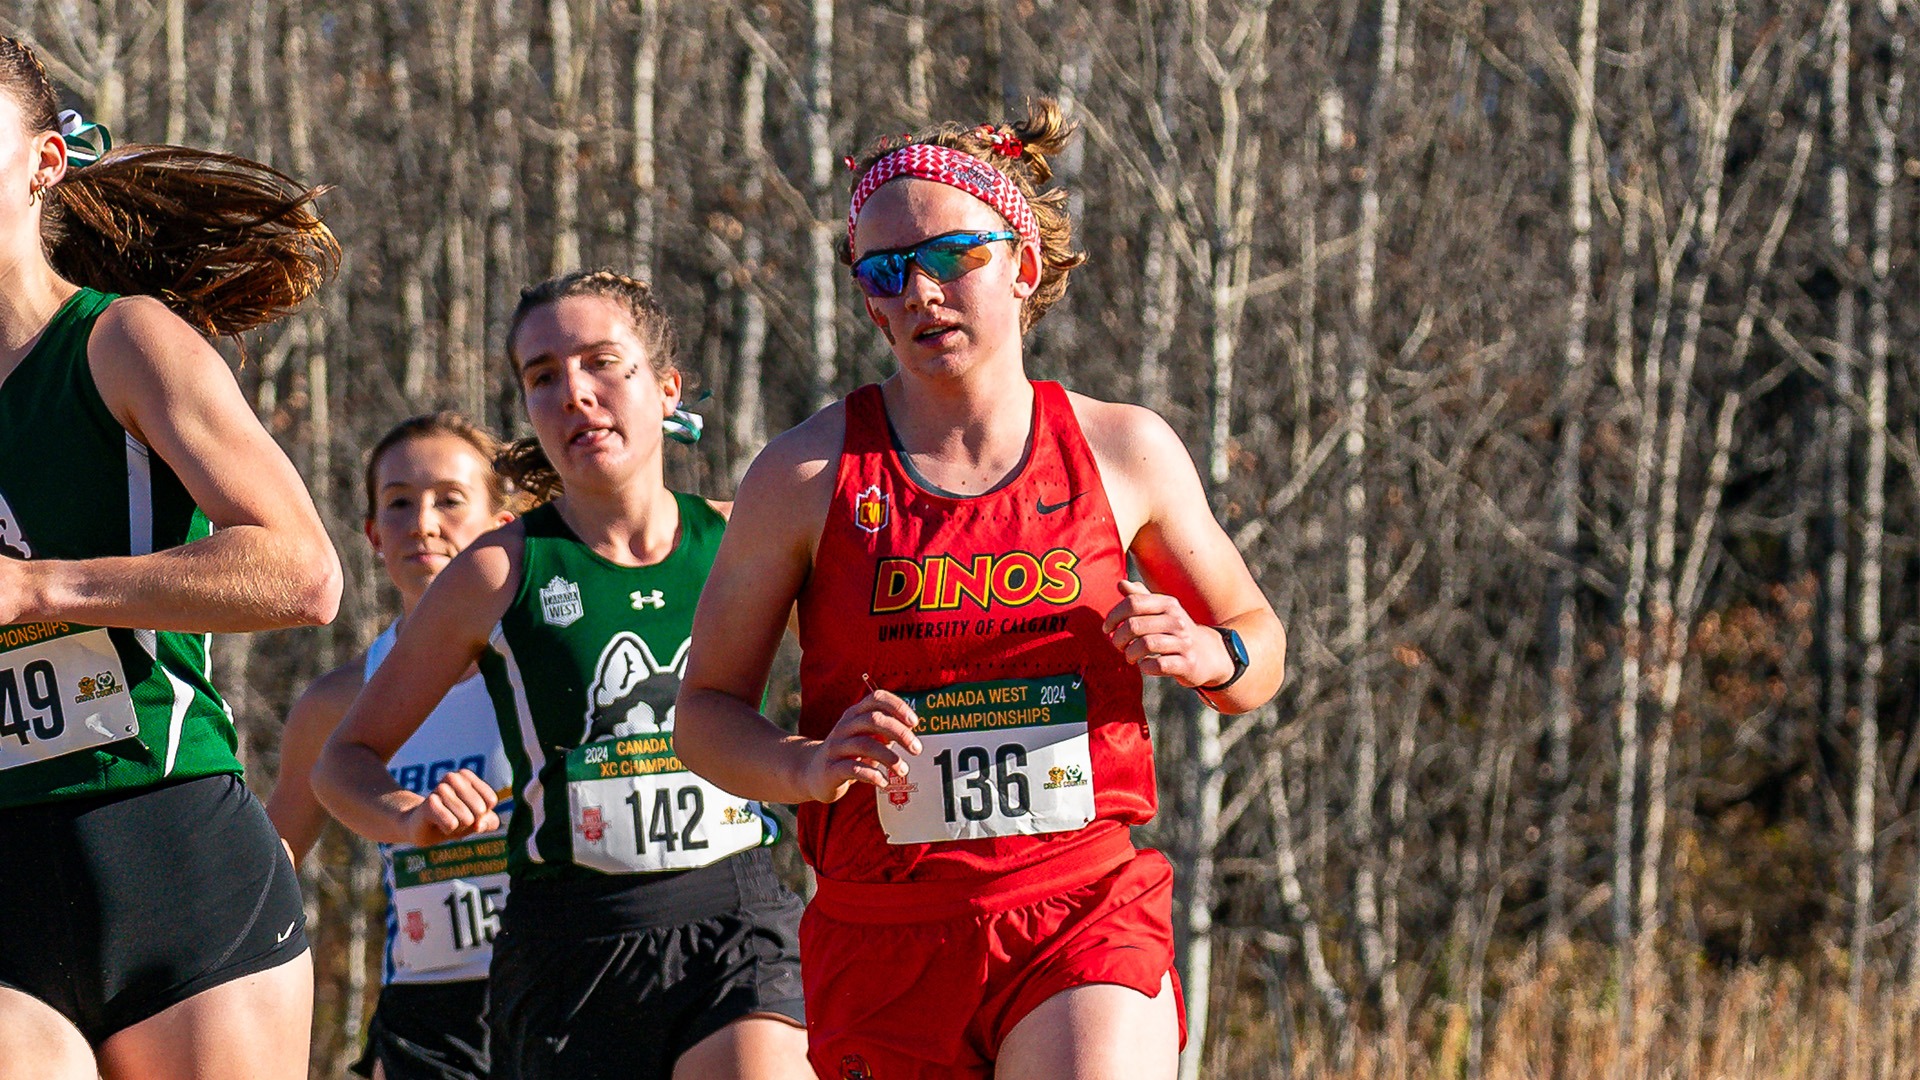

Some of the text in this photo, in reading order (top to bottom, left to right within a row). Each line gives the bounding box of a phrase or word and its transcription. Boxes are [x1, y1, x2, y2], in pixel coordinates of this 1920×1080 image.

[870, 548, 1081, 615] DINOS
[548, 603, 577, 618] WEST
[878, 615, 1070, 642] UNIVERSITY OF CALGARY
[926, 690, 986, 709] CANADA
[989, 686, 1029, 704] WEST
[1040, 685, 1067, 705] 2024
[930, 707, 1051, 732] CHAMPIONSHIPS
[584, 746, 609, 765] 2024
[616, 738, 668, 756] CANADA
[600, 761, 618, 777] XC
[933, 743, 1031, 823] 136
[625, 785, 710, 857] 142
[429, 846, 475, 865] CANADA
[443, 884, 504, 950] 115
